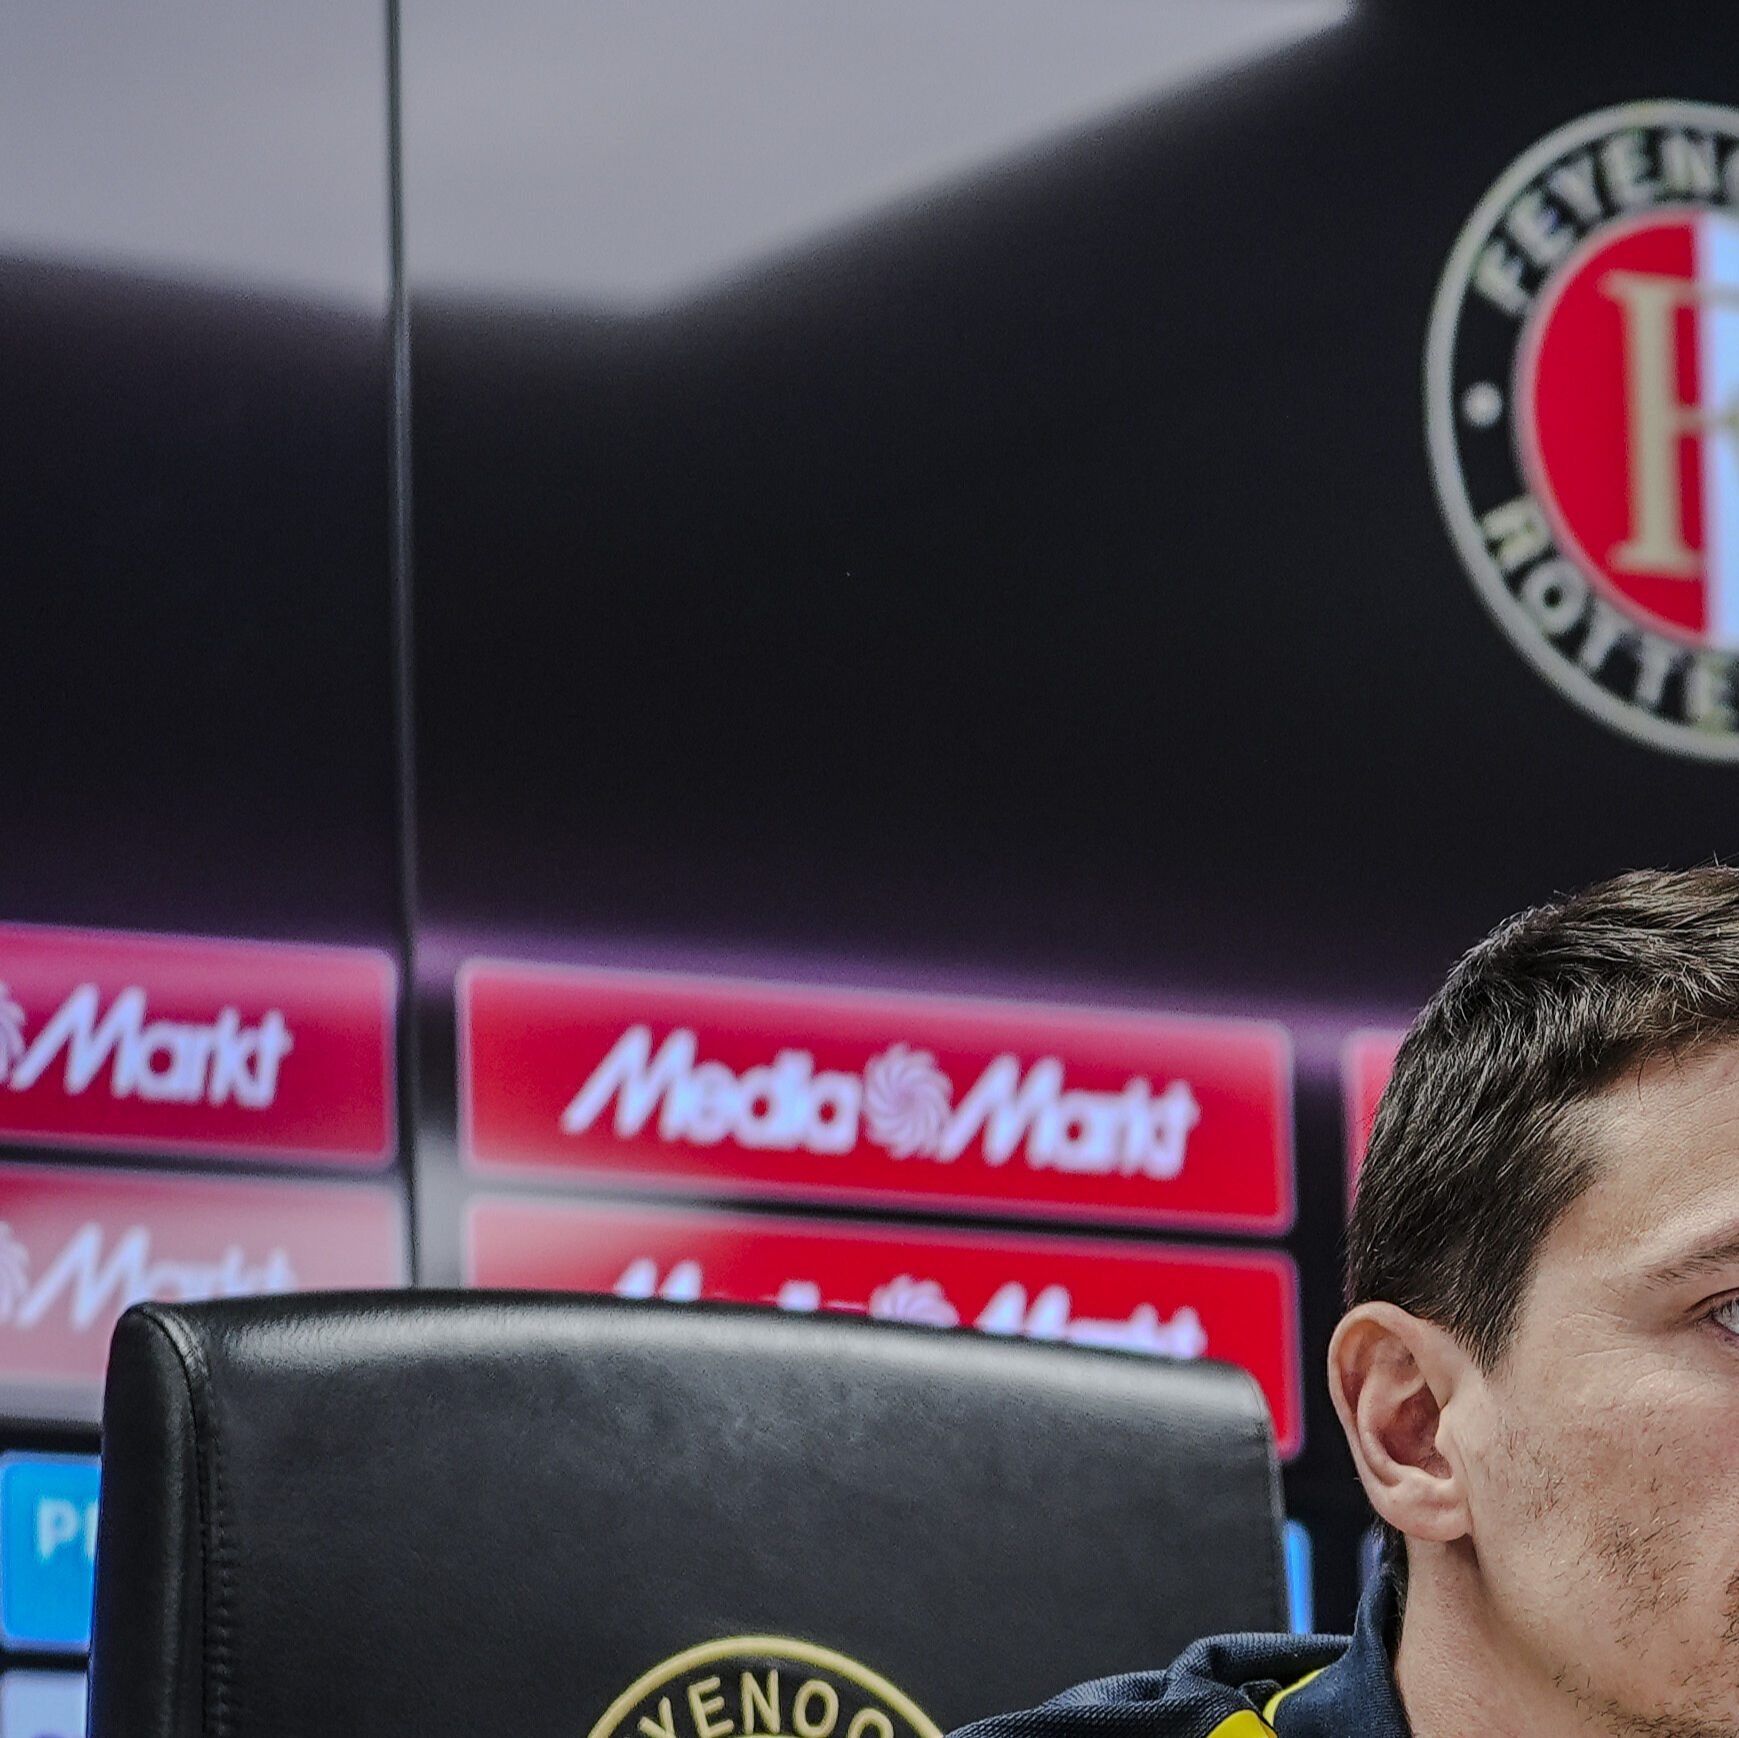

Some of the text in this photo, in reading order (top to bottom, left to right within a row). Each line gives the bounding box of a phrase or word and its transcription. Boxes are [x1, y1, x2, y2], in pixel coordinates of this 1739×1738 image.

[8, 980, 296, 1110] Markt
[560, 1024, 1201, 1181] Media Markt
